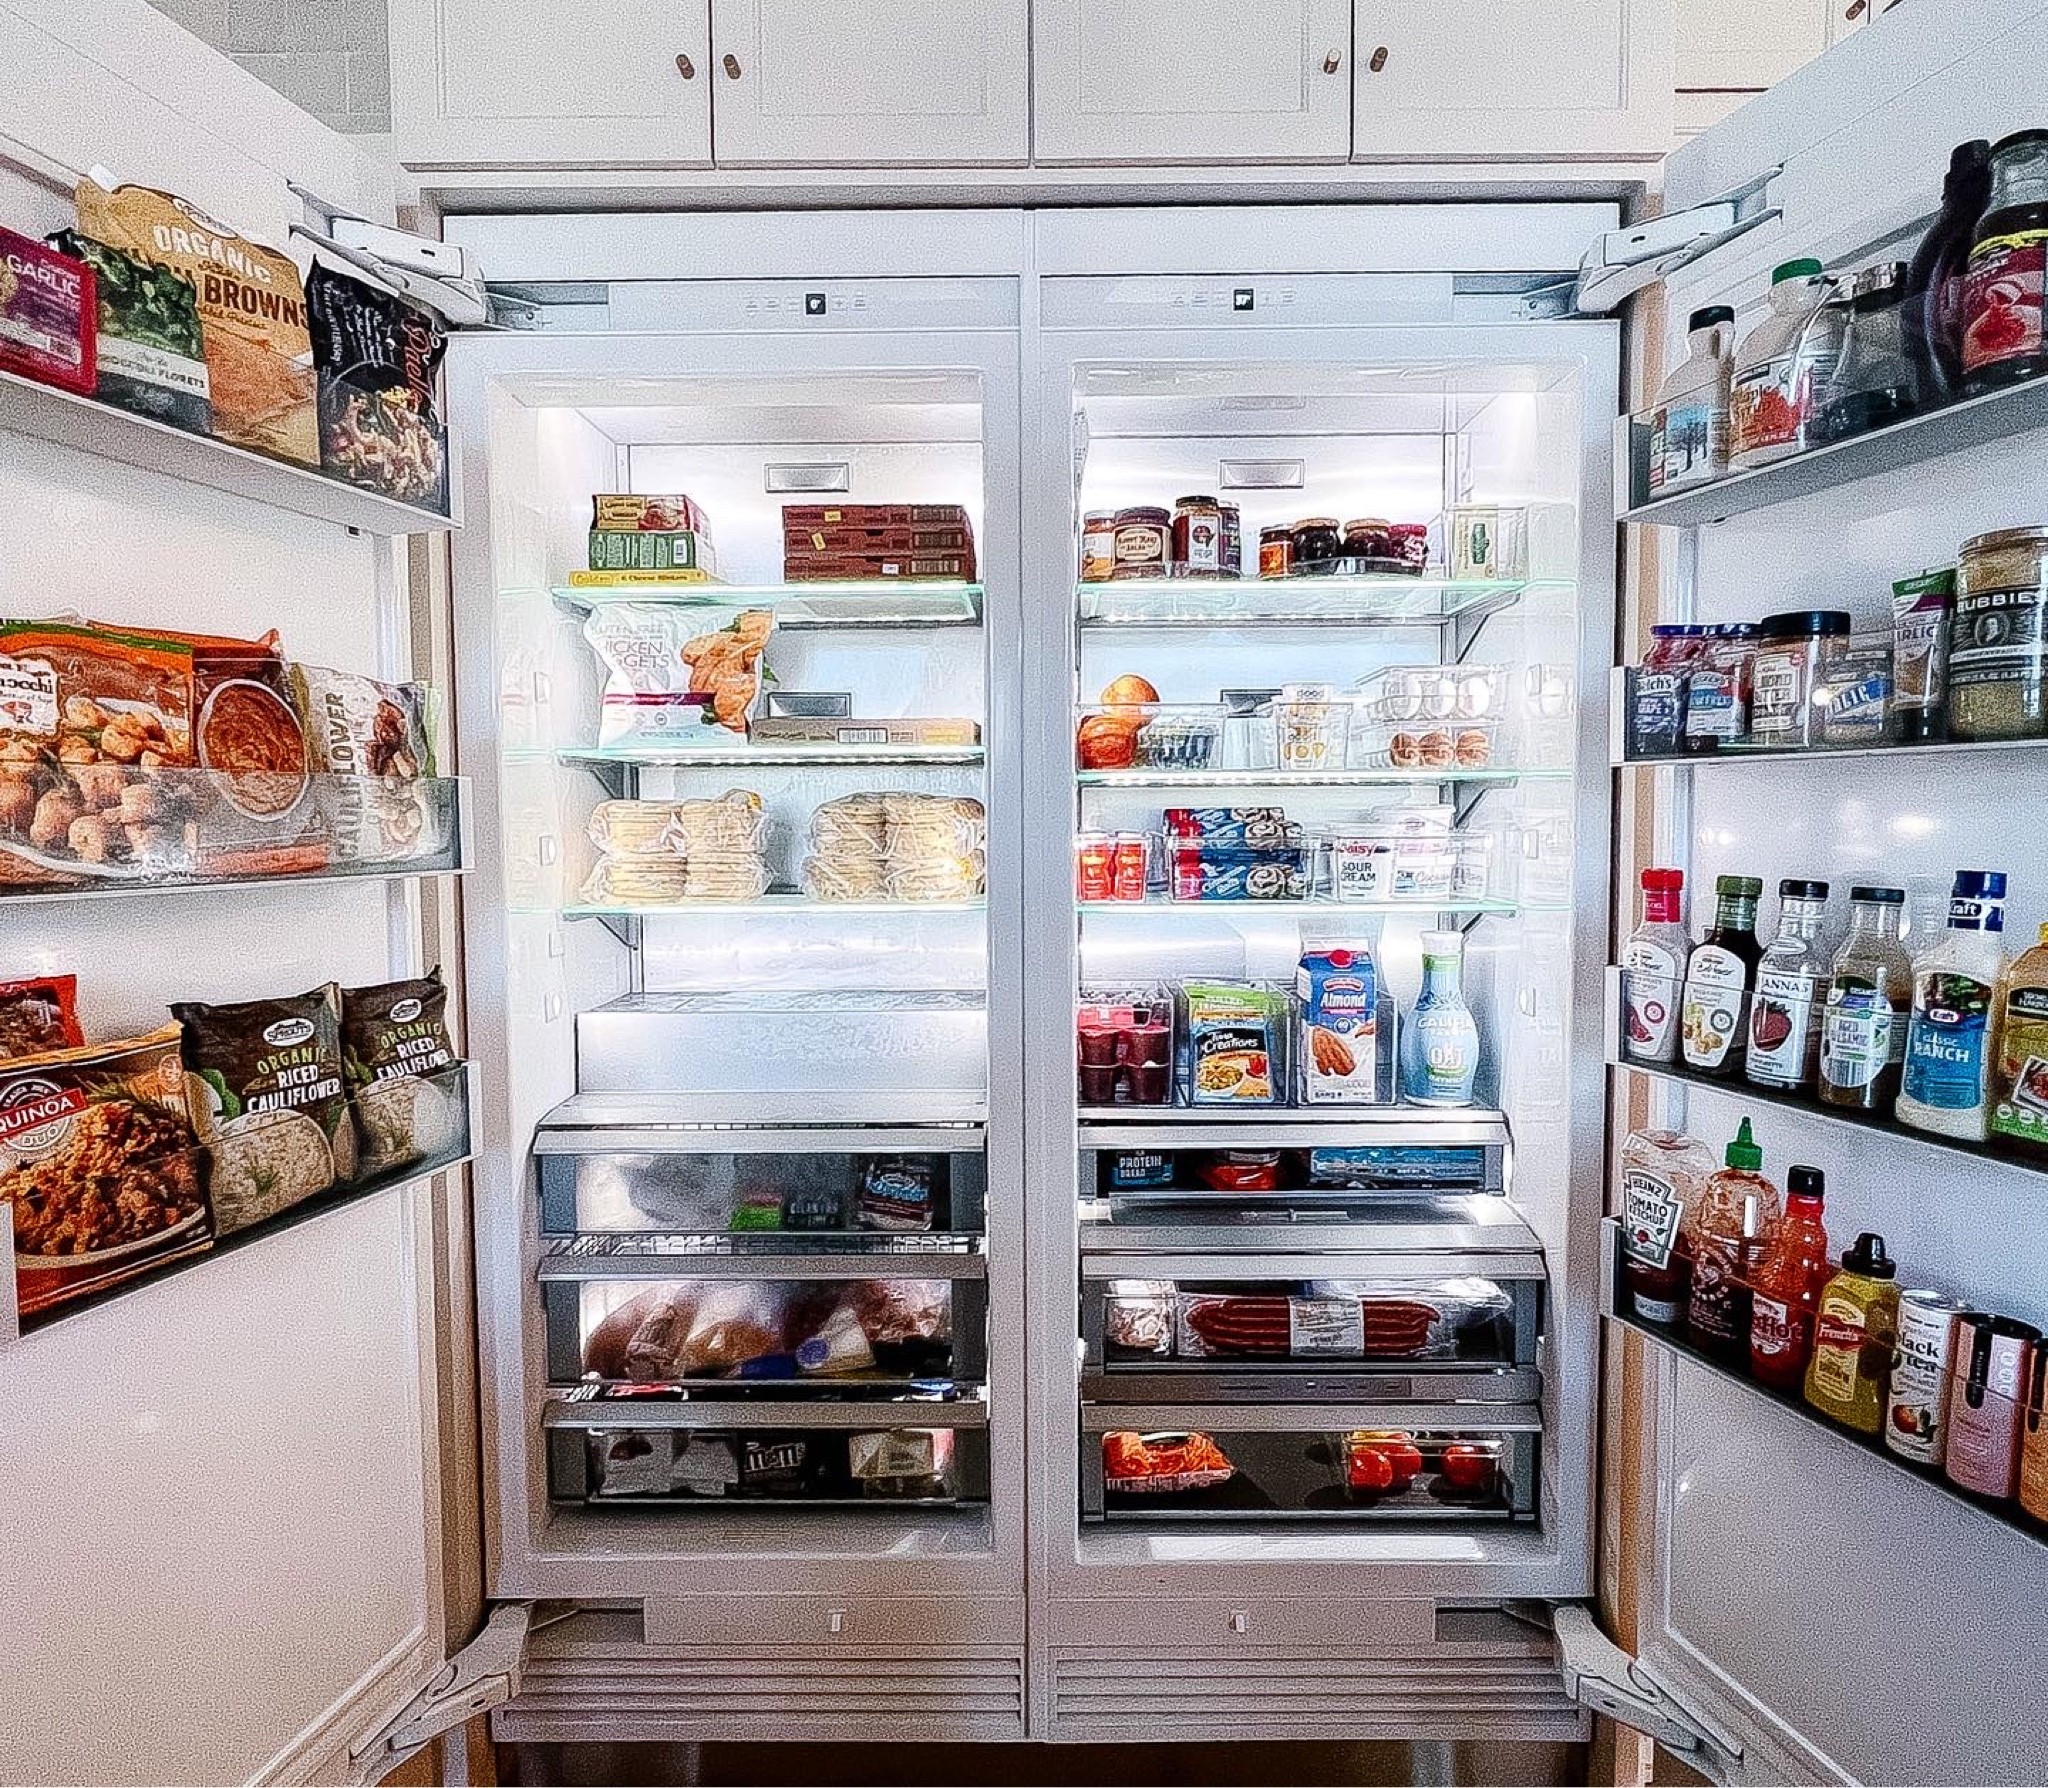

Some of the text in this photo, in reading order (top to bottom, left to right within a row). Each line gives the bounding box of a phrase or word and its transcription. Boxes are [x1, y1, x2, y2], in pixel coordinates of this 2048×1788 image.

[154, 225, 271, 284] ORGANIC
[6, 253, 81, 299] GARLIC
[0, 677, 53, 695] nocchi
[1320, 991, 1367, 1009] Almond
[380, 1022, 443, 1049] ORGANIC
[1204, 1037, 1258, 1053] Creations
[1207, 1031, 1234, 1041] Tuna
[396, 1037, 436, 1059] RICED
[1913, 1041, 1969, 1063] RANCH
[256, 1047, 328, 1075] ORGANIC
[276, 1064, 319, 1089] RICED
[247, 1077, 342, 1114] CAULIFLOWER
[0, 1096, 75, 1133] QUINOA
[22, 1126, 59, 1147] DUO
[1119, 1155, 1163, 1168] PROTEIN
[1633, 1177, 1663, 1198] HEINZ
[1628, 1192, 1669, 1217] TOMATO
[1906, 1353, 1938, 1373] tea
